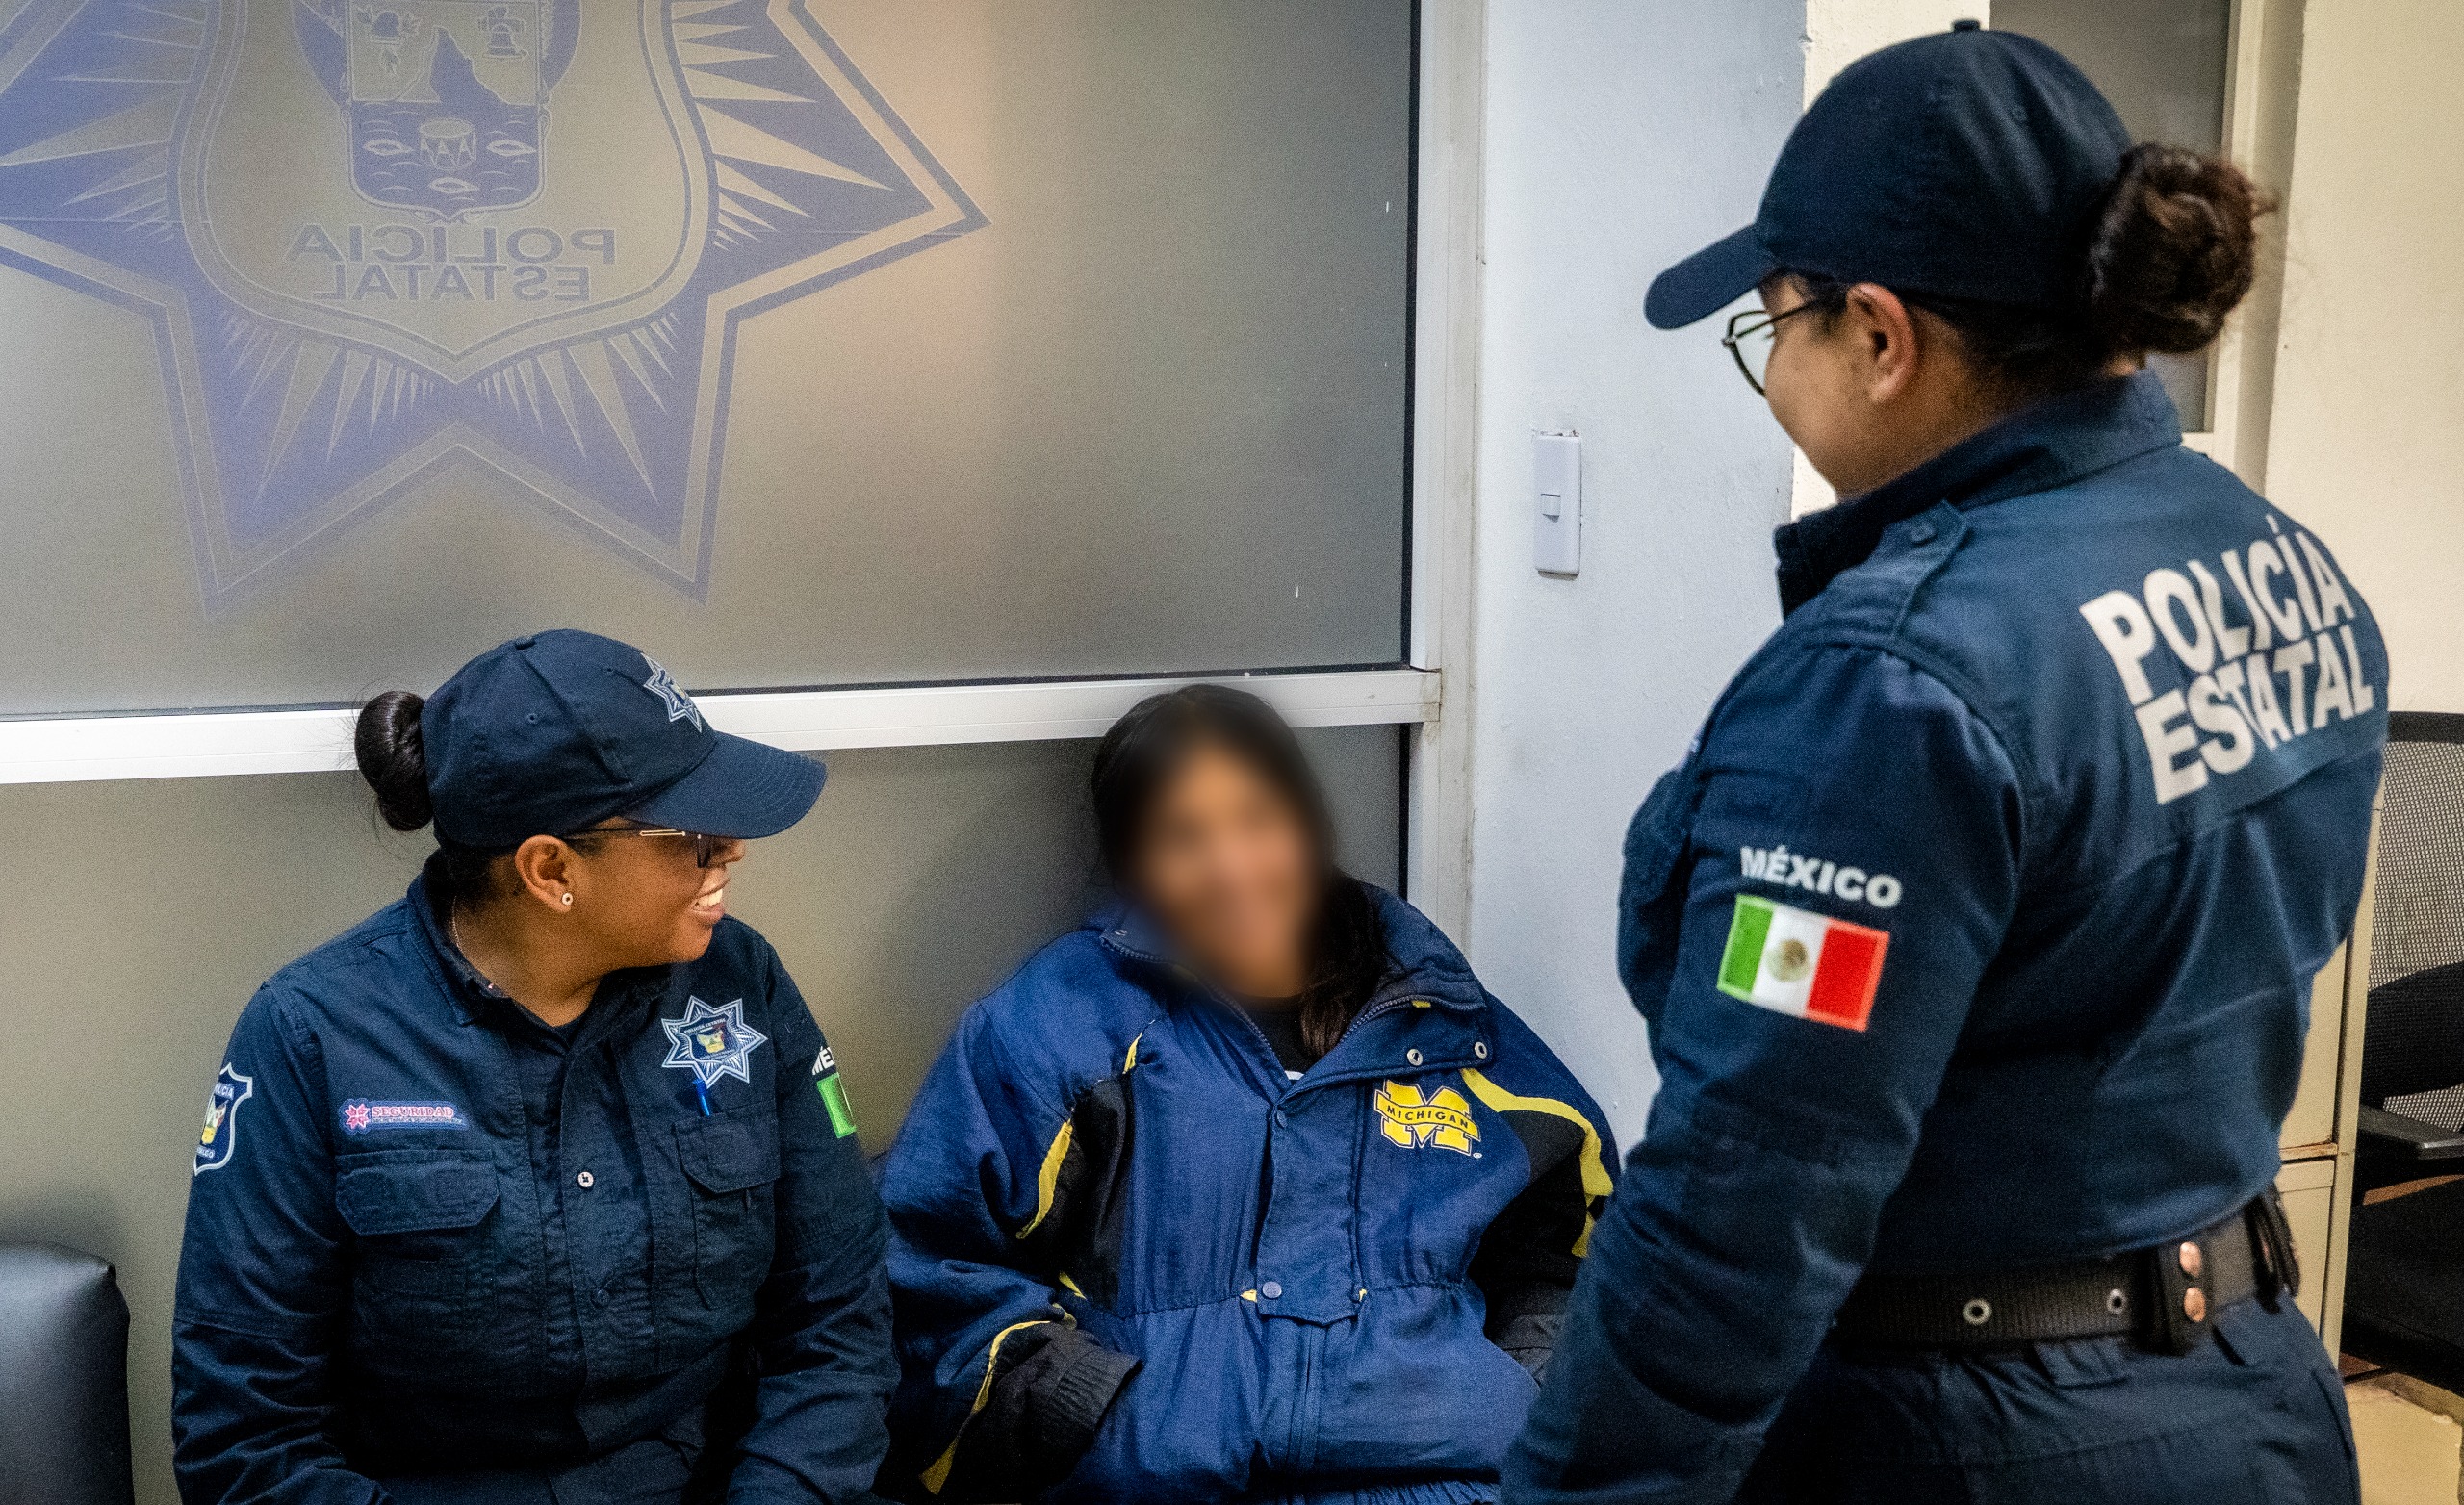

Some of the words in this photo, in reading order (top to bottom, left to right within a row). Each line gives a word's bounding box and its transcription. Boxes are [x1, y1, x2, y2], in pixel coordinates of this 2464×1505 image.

[2078, 514, 2356, 707] POLICÍA
[2134, 624, 2374, 806] ESTATAL
[1739, 844, 1903, 909] MÉXICO
[372, 1106, 454, 1118] SEGURIDAD
[1386, 1105, 1470, 1129] MICHIGAN
